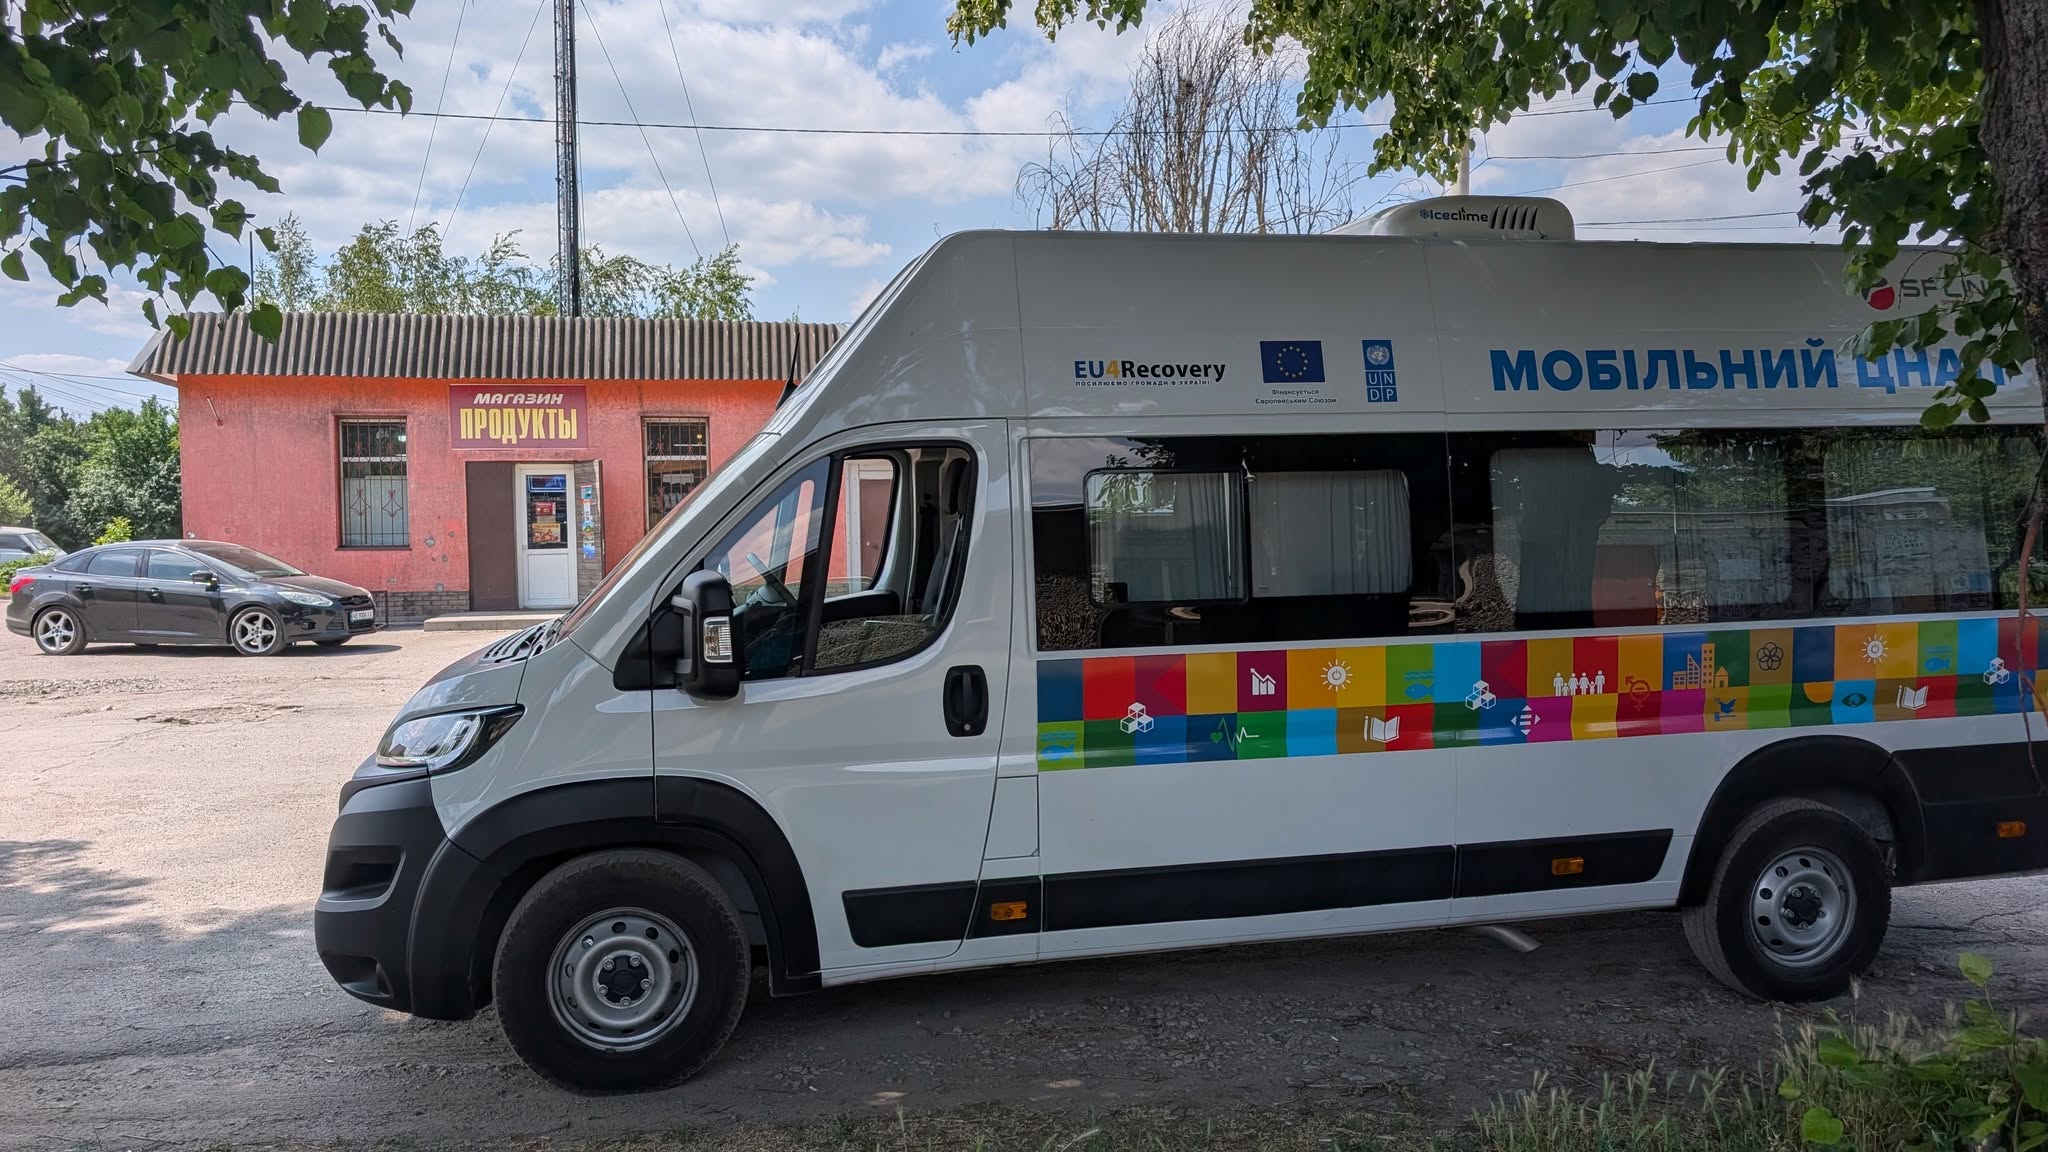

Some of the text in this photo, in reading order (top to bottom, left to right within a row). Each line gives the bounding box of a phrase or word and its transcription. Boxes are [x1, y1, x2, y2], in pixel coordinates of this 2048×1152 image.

[1074, 360, 1226, 382] EU4Recovery
[1489, 337, 1838, 391] МОБІЛЬНИЙ
[473, 393, 564, 405] МАГАЗИН
[460, 408, 578, 445] ПРОДУКТЫ
